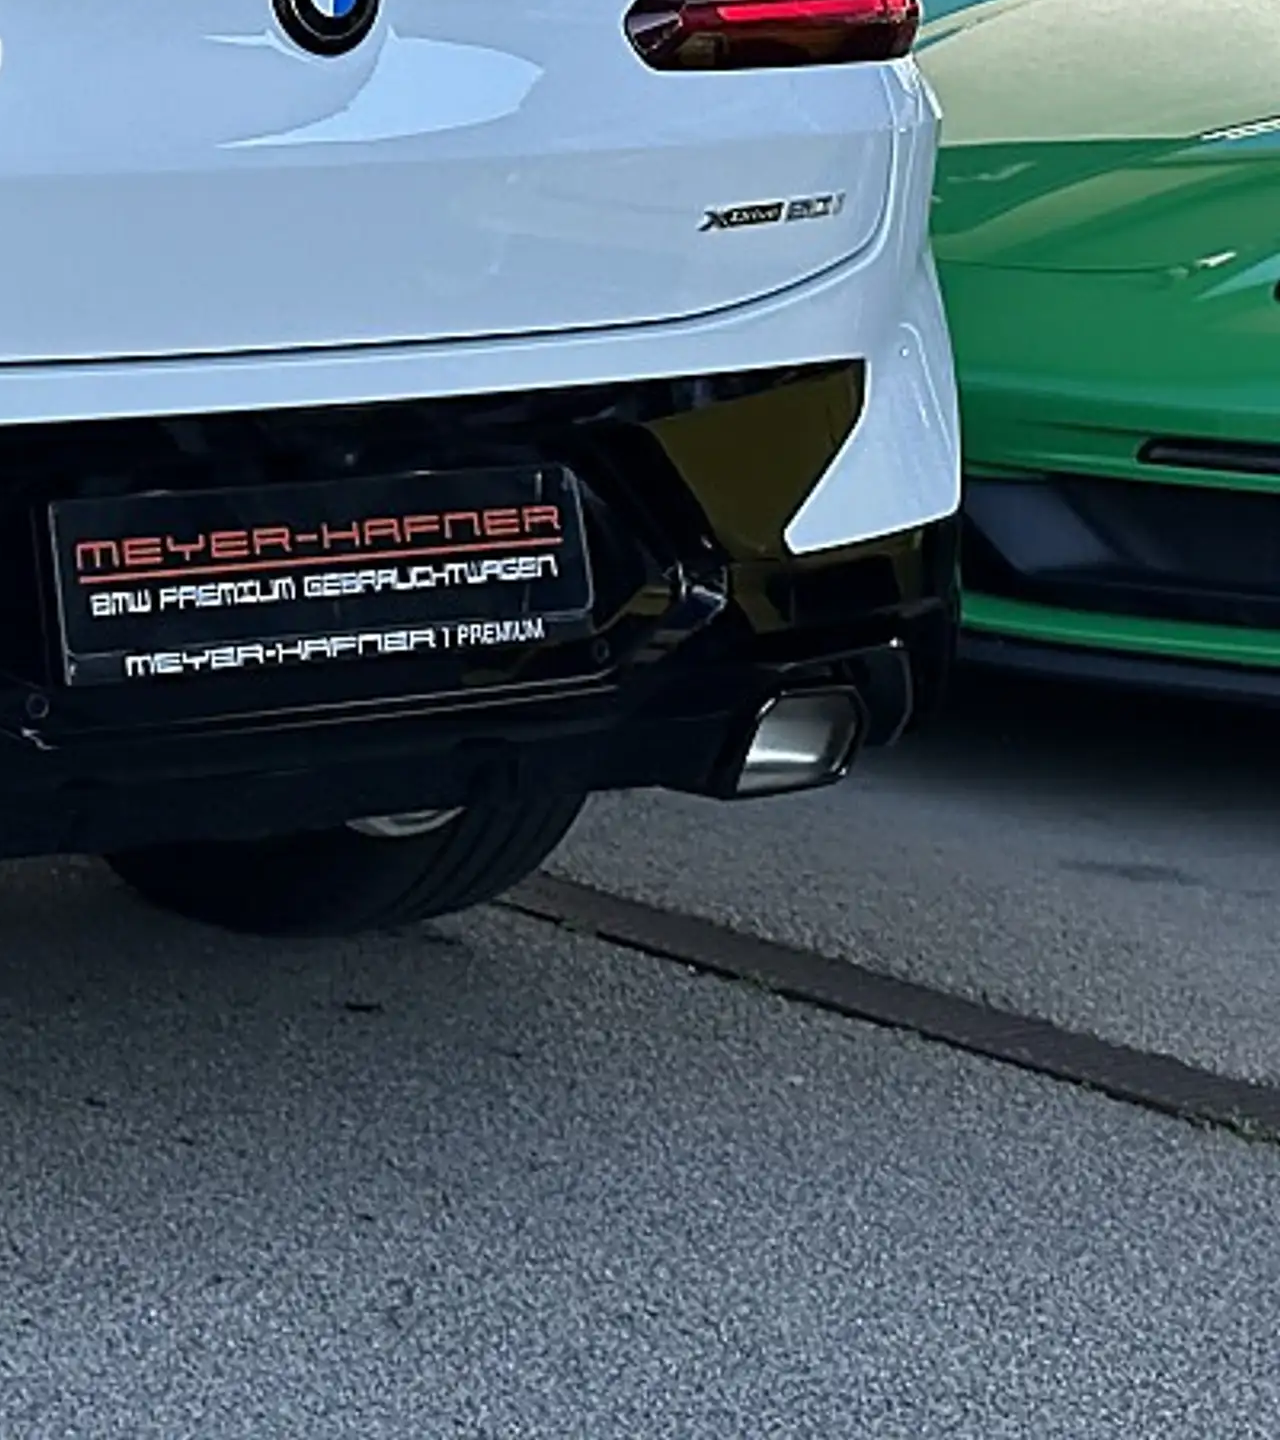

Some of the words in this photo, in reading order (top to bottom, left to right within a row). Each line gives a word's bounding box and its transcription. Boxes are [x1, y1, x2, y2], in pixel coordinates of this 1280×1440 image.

[76, 504, 560, 570] MEYER-HAFNER
[90, 588, 152, 617] BMW
[159, 576, 296, 611] PREMIUM
[303, 554, 558, 597] GEBRAUCHTWAGEN
[125, 626, 437, 676] MEYER-HAFNER
